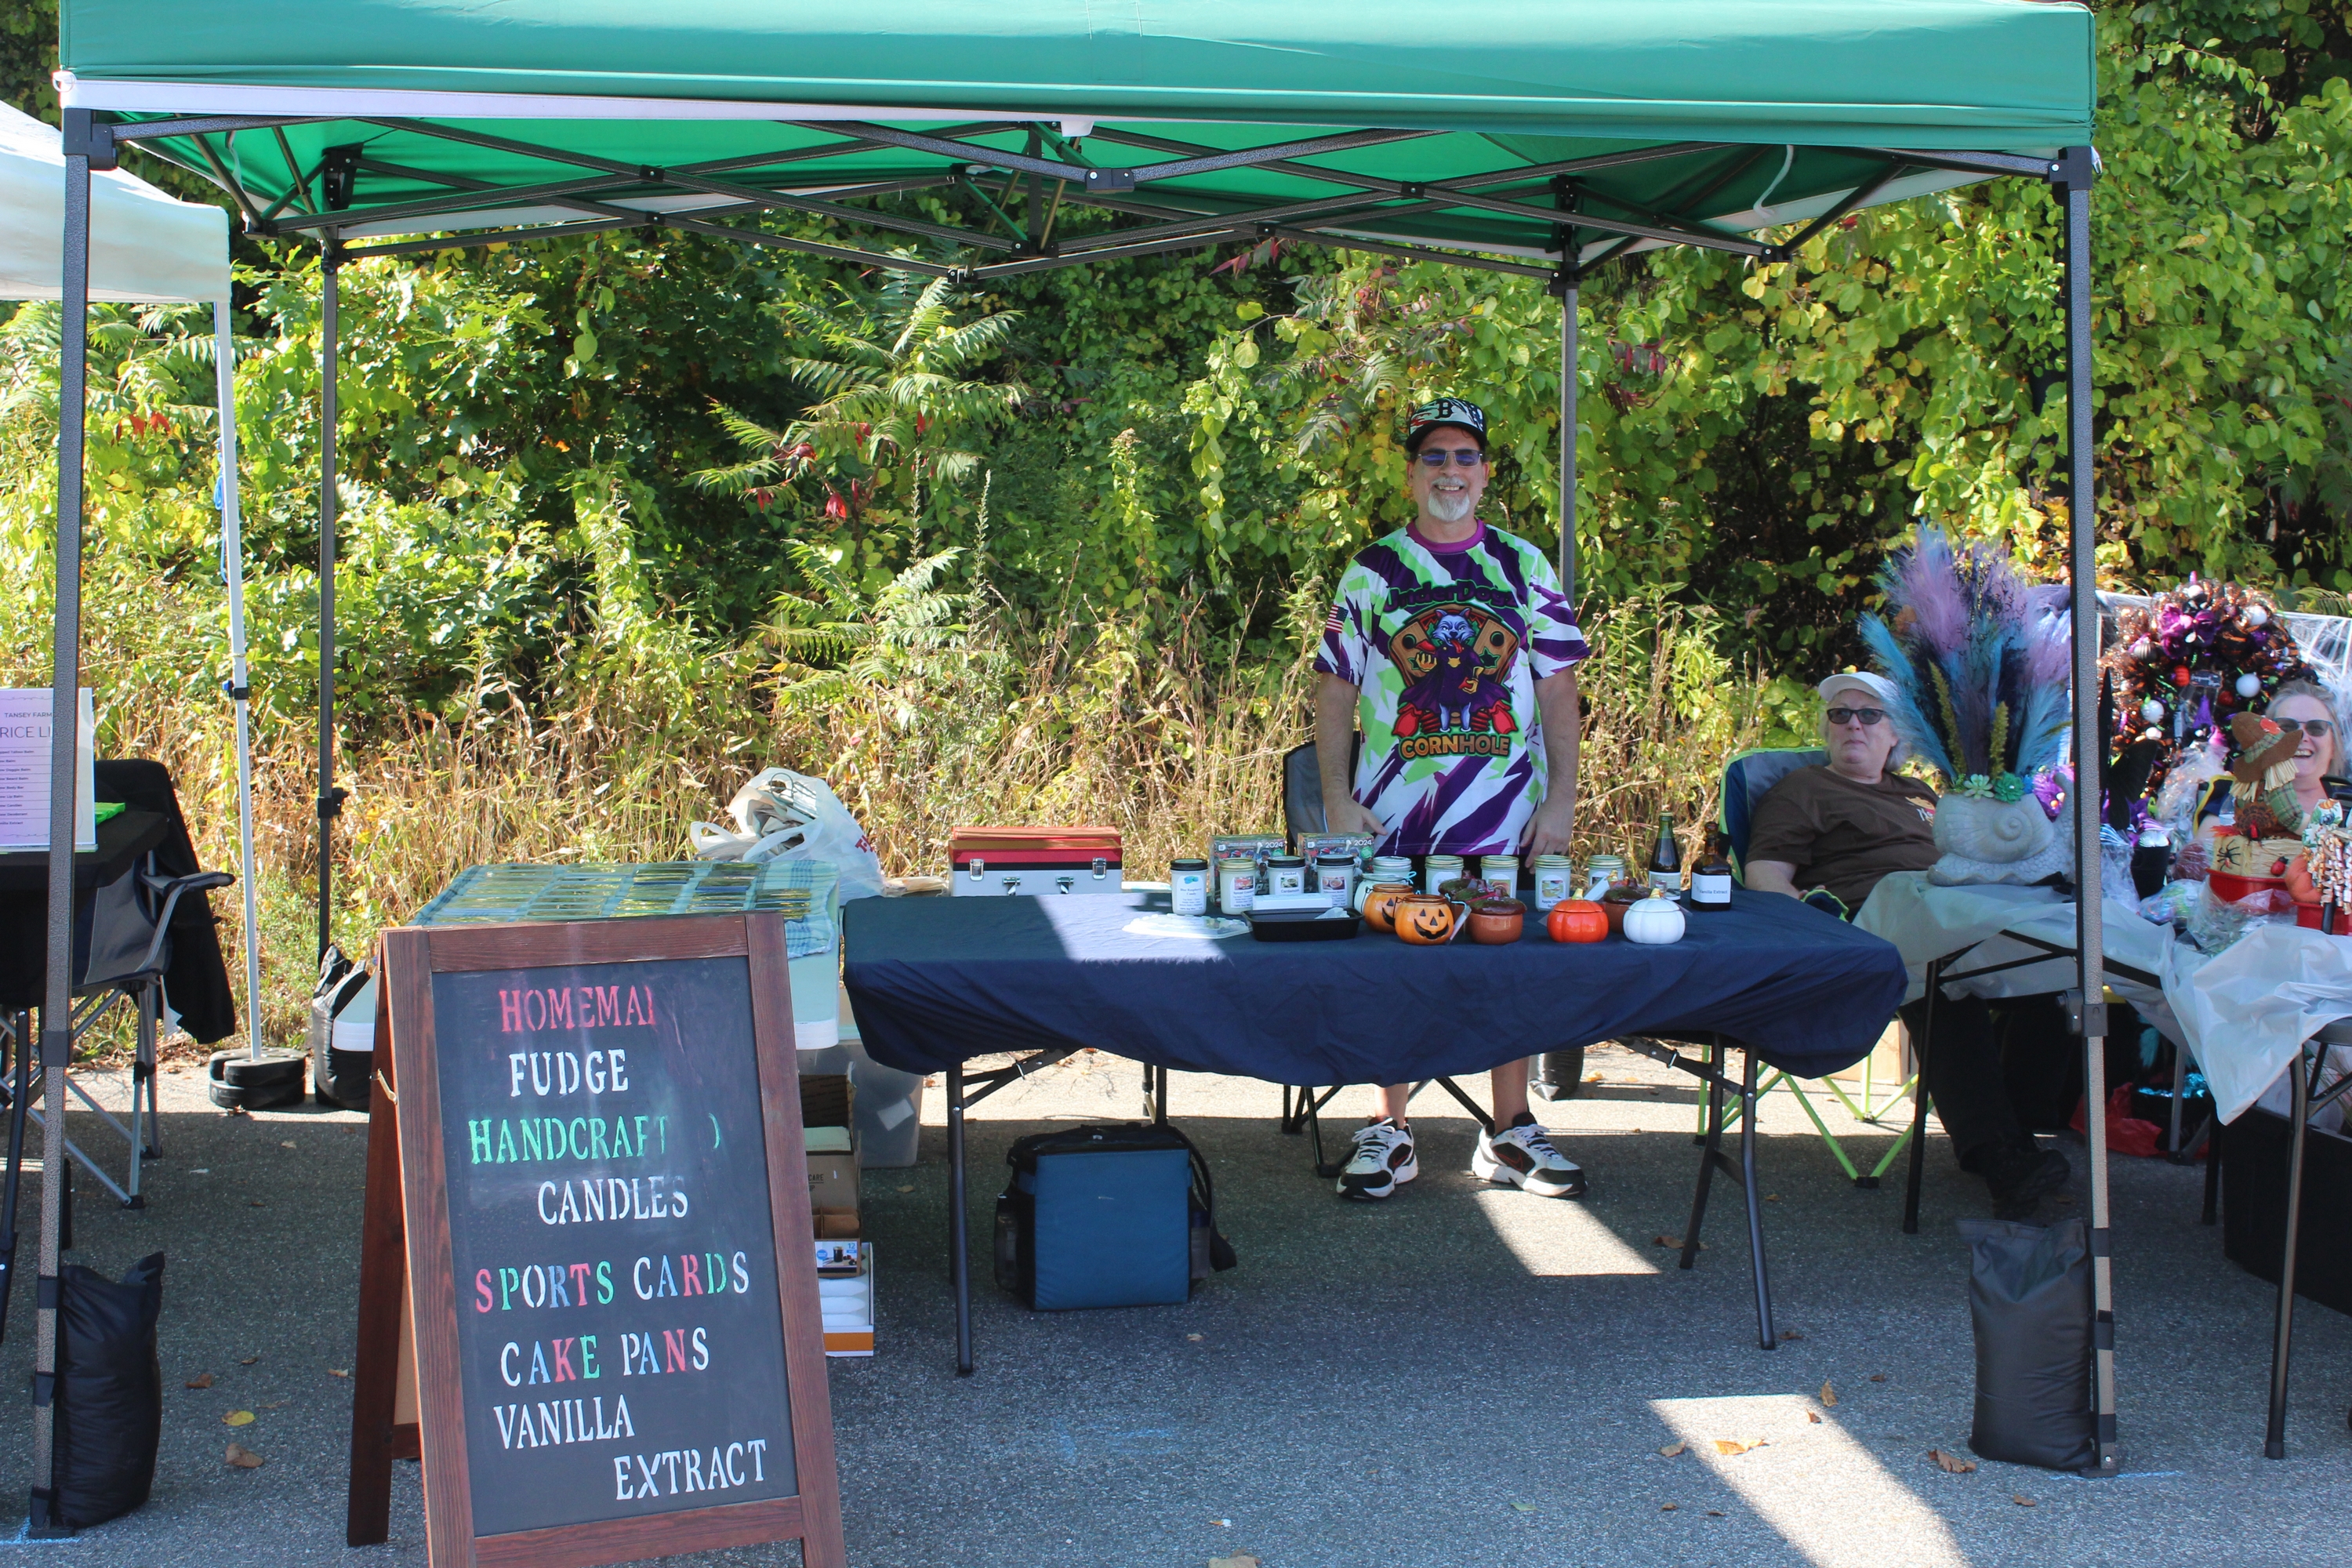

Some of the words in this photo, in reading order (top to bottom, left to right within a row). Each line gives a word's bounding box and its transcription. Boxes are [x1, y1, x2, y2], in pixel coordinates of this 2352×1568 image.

[1434, 400, 1454, 419] B
[0, 726, 35, 738] RICE
[39, 726, 51, 738] LI
[1400, 734, 1511, 759] CORNHOLE
[499, 985, 656, 1033] HOMEMA
[509, 1048, 630, 1097] FUDGE
[468, 1112, 720, 1164] HANDCRAFT
[537, 1175, 689, 1225] CANDLES
[475, 1260, 615, 1313] SPORTS
[633, 1250, 750, 1301] CARDS
[500, 1334, 601, 1388] CAKE
[620, 1327, 710, 1377] PANS
[493, 1394, 636, 1449] VANILLA
[612, 1439, 768, 1501] EXTRACT
